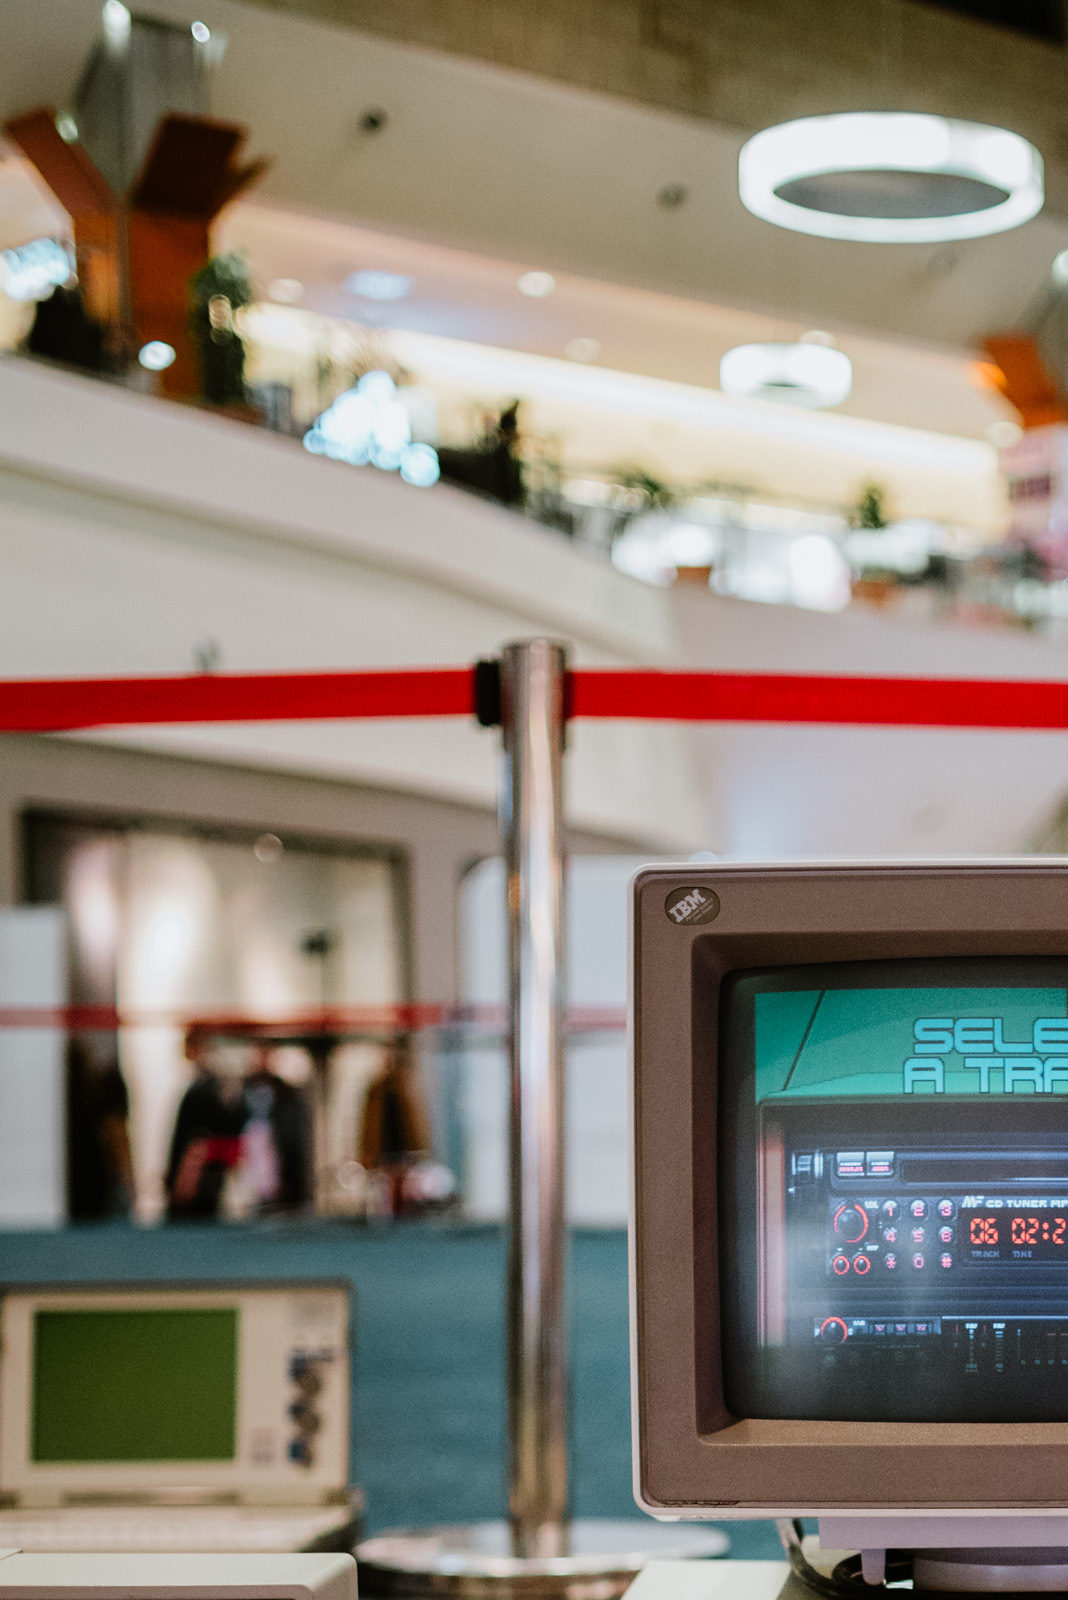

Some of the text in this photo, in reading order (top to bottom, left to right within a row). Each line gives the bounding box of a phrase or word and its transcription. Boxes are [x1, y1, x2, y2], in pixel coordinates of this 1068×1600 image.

[669, 888, 707, 923] IBM
[903, 1057, 945, 1093] A
[970, 1218, 998, 1244] 06
